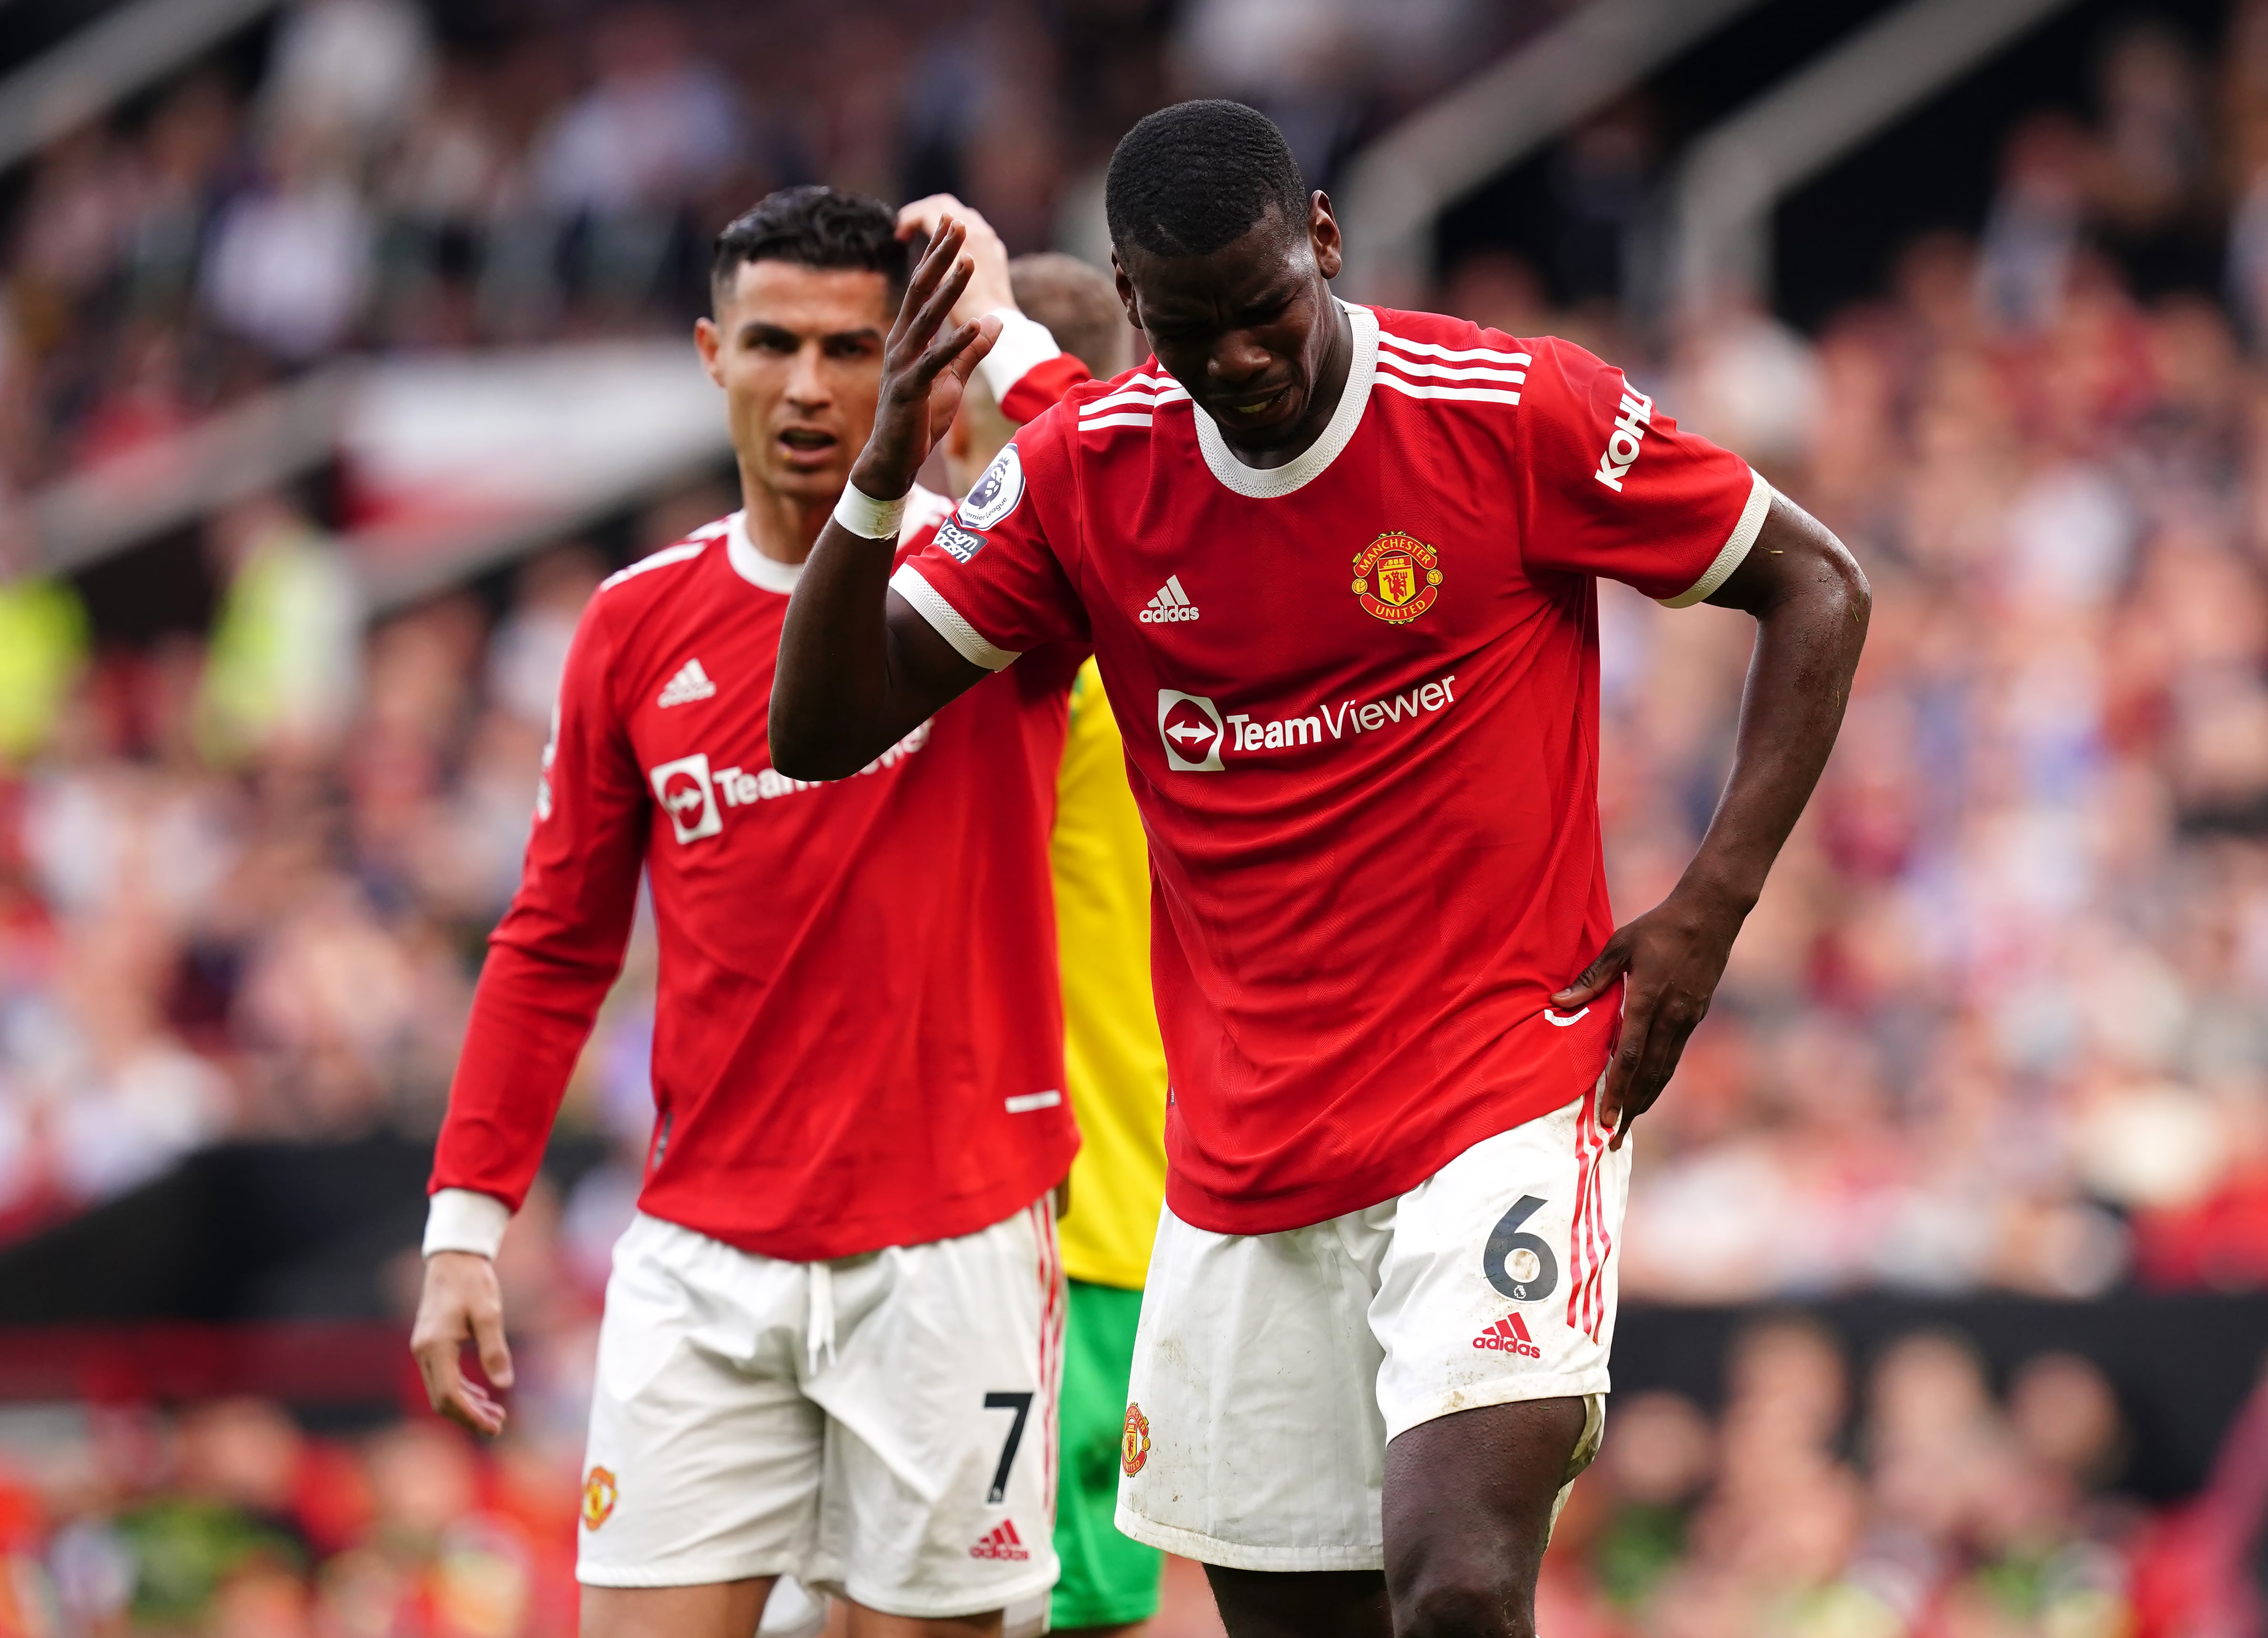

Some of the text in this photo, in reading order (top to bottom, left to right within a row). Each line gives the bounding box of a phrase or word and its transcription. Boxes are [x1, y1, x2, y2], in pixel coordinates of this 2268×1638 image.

[985, 497, 1007, 519] League
[933, 532, 972, 564] acism
[1359, 538, 1431, 571] MANCHESTER
[1139, 604, 1200, 623] adidas
[1375, 600, 1426, 618] UNITED
[1226, 675, 1456, 752] TeamViewer
[1483, 1194, 1559, 1302] 6
[1472, 1335, 1540, 1359] adidas
[984, 1392, 1034, 1504] 7
